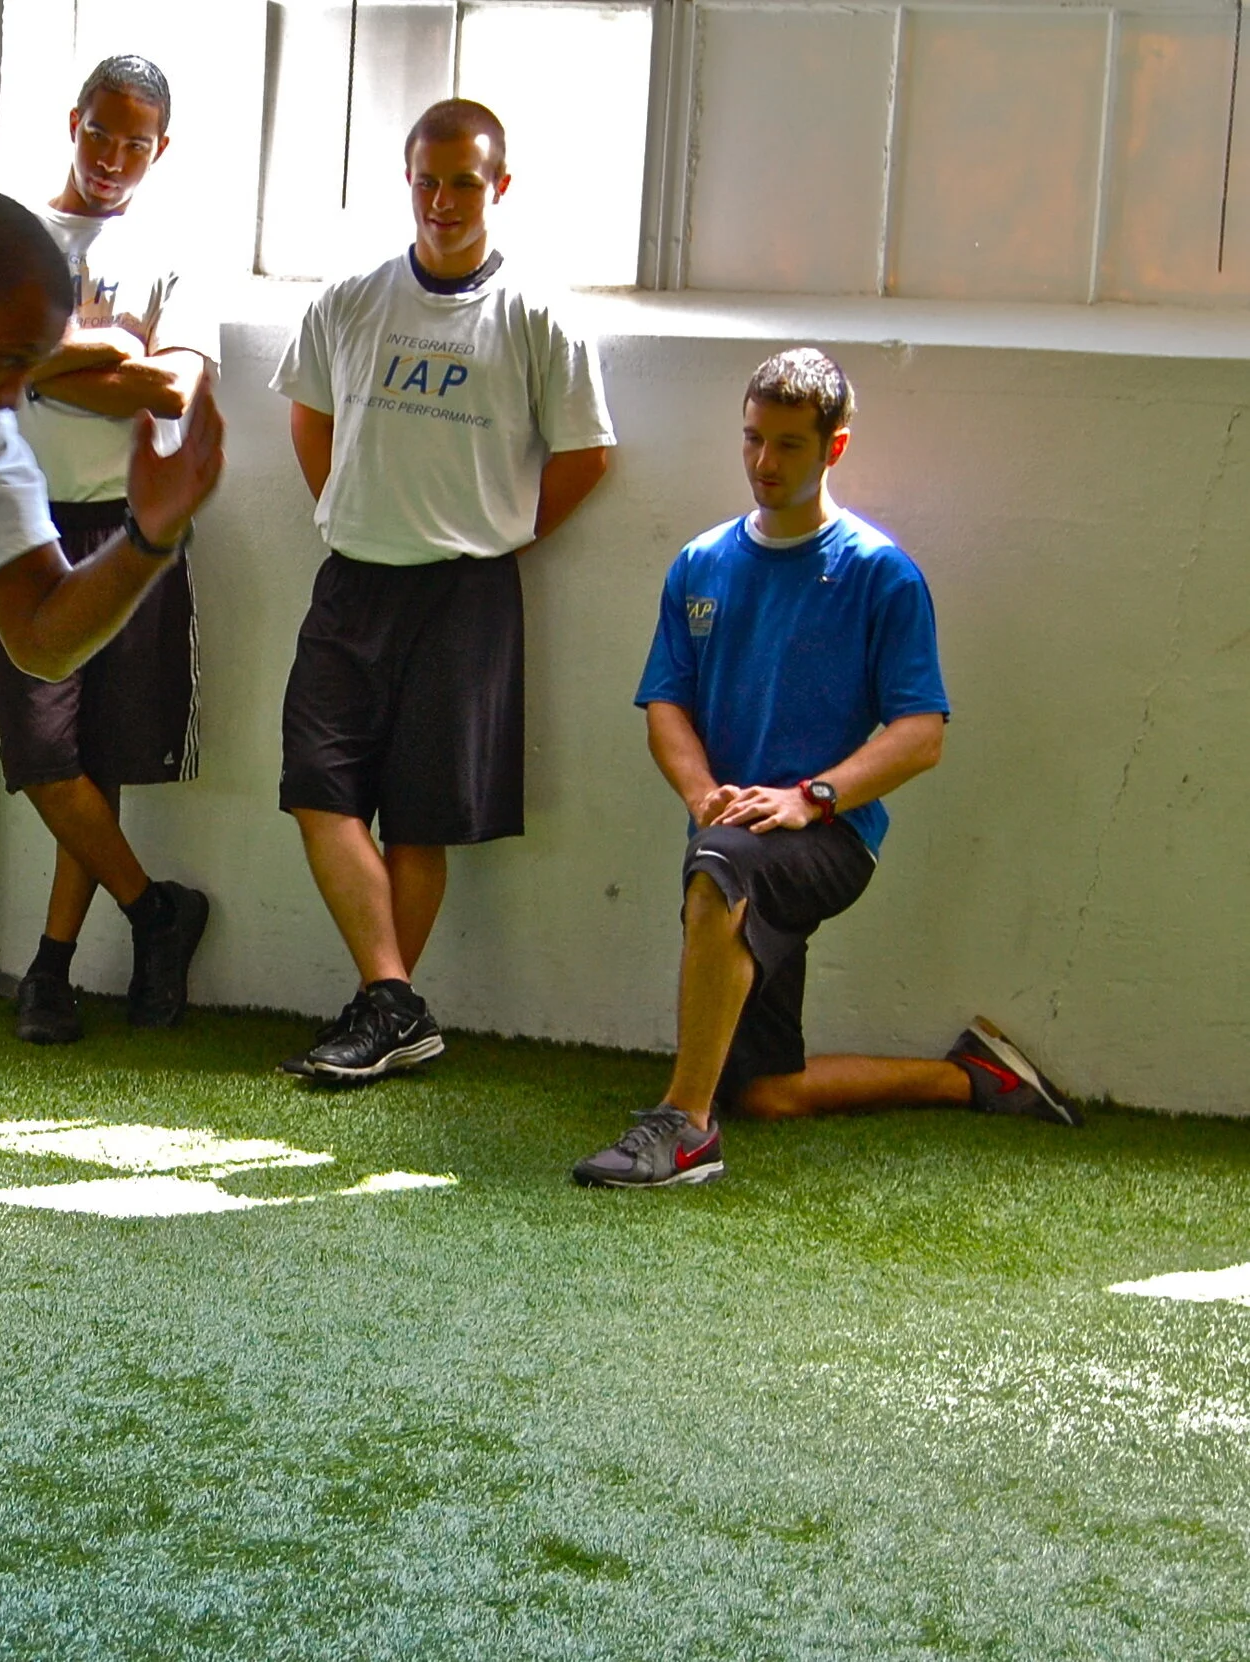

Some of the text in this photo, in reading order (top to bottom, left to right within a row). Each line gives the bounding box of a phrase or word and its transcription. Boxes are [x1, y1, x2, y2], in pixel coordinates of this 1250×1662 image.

[386, 333, 475, 355] INTEGRATED
[383, 355, 468, 397] IAP
[398, 403, 493, 429] PERFORMANCE
